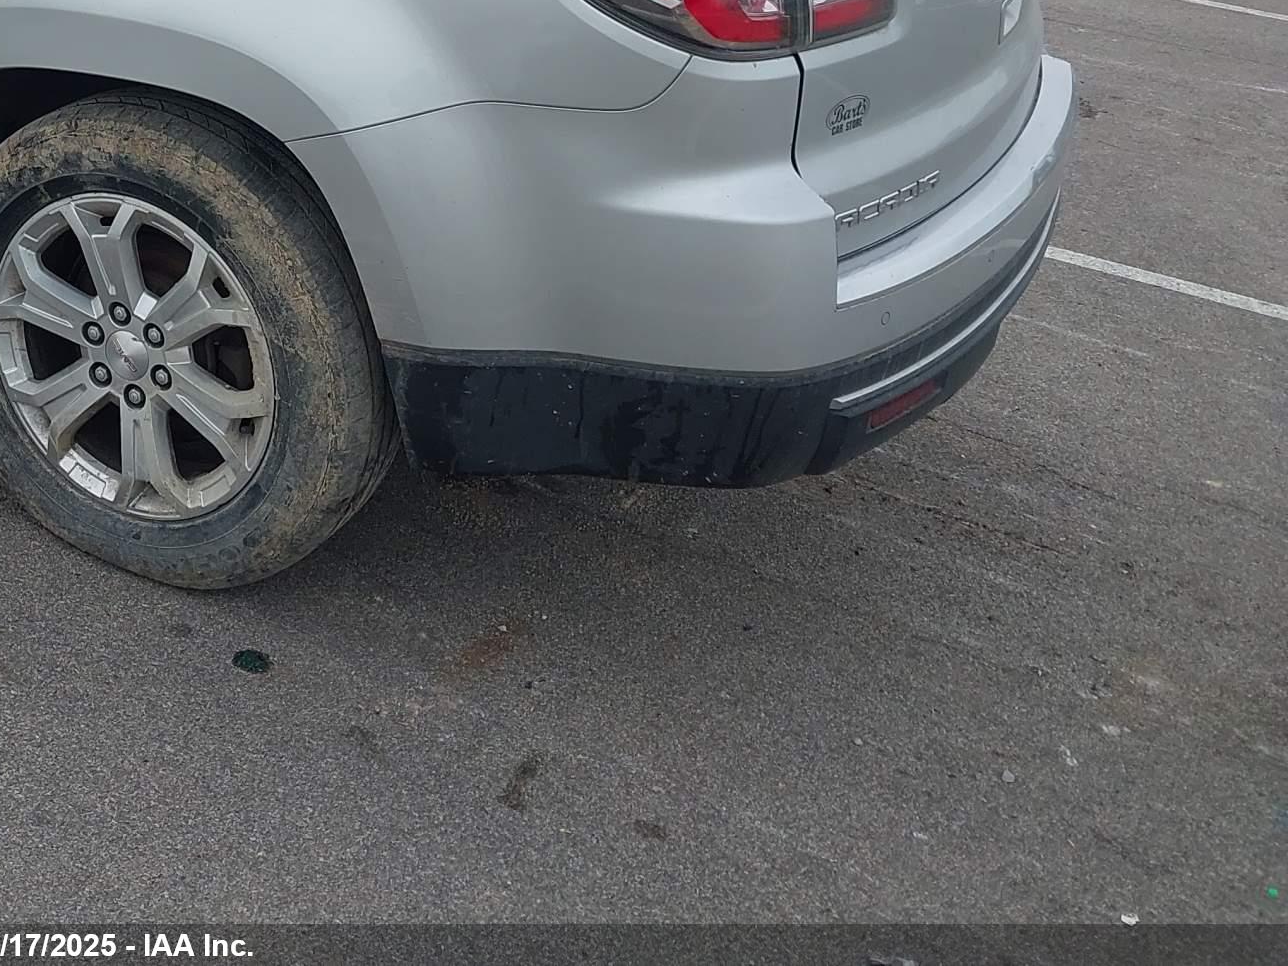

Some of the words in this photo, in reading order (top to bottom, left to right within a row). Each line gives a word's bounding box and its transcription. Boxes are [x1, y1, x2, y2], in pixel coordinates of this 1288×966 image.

[831, 98, 867, 125] Bart's
[831, 124, 844, 136] CAR
[845, 117, 863, 131] STORE
[834, 170, 940, 229] ACADIA
